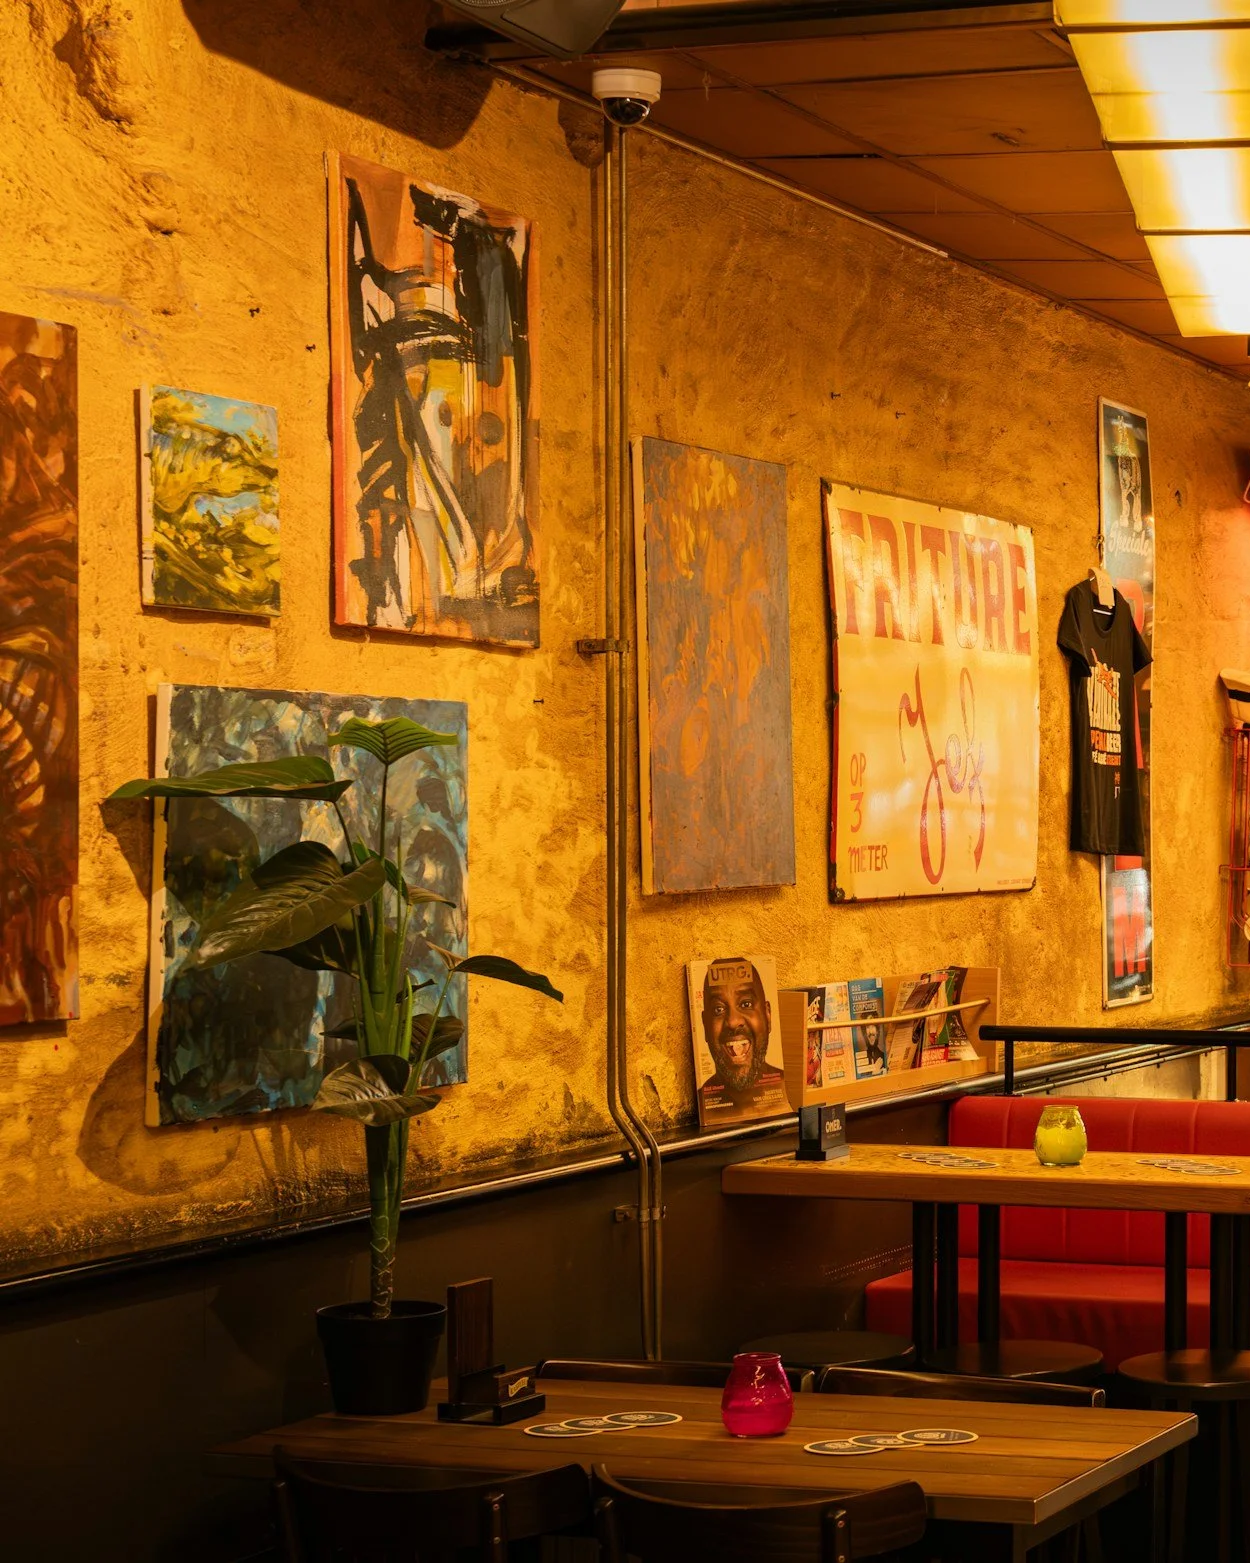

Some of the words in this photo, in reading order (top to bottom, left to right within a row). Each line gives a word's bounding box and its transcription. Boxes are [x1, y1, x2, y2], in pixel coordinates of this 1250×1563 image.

[838, 507, 1031, 656] FRITURE
[849, 752, 867, 786] OP
[850, 792, 864, 834] 3
[825, 1118, 842, 1134] OMER.
